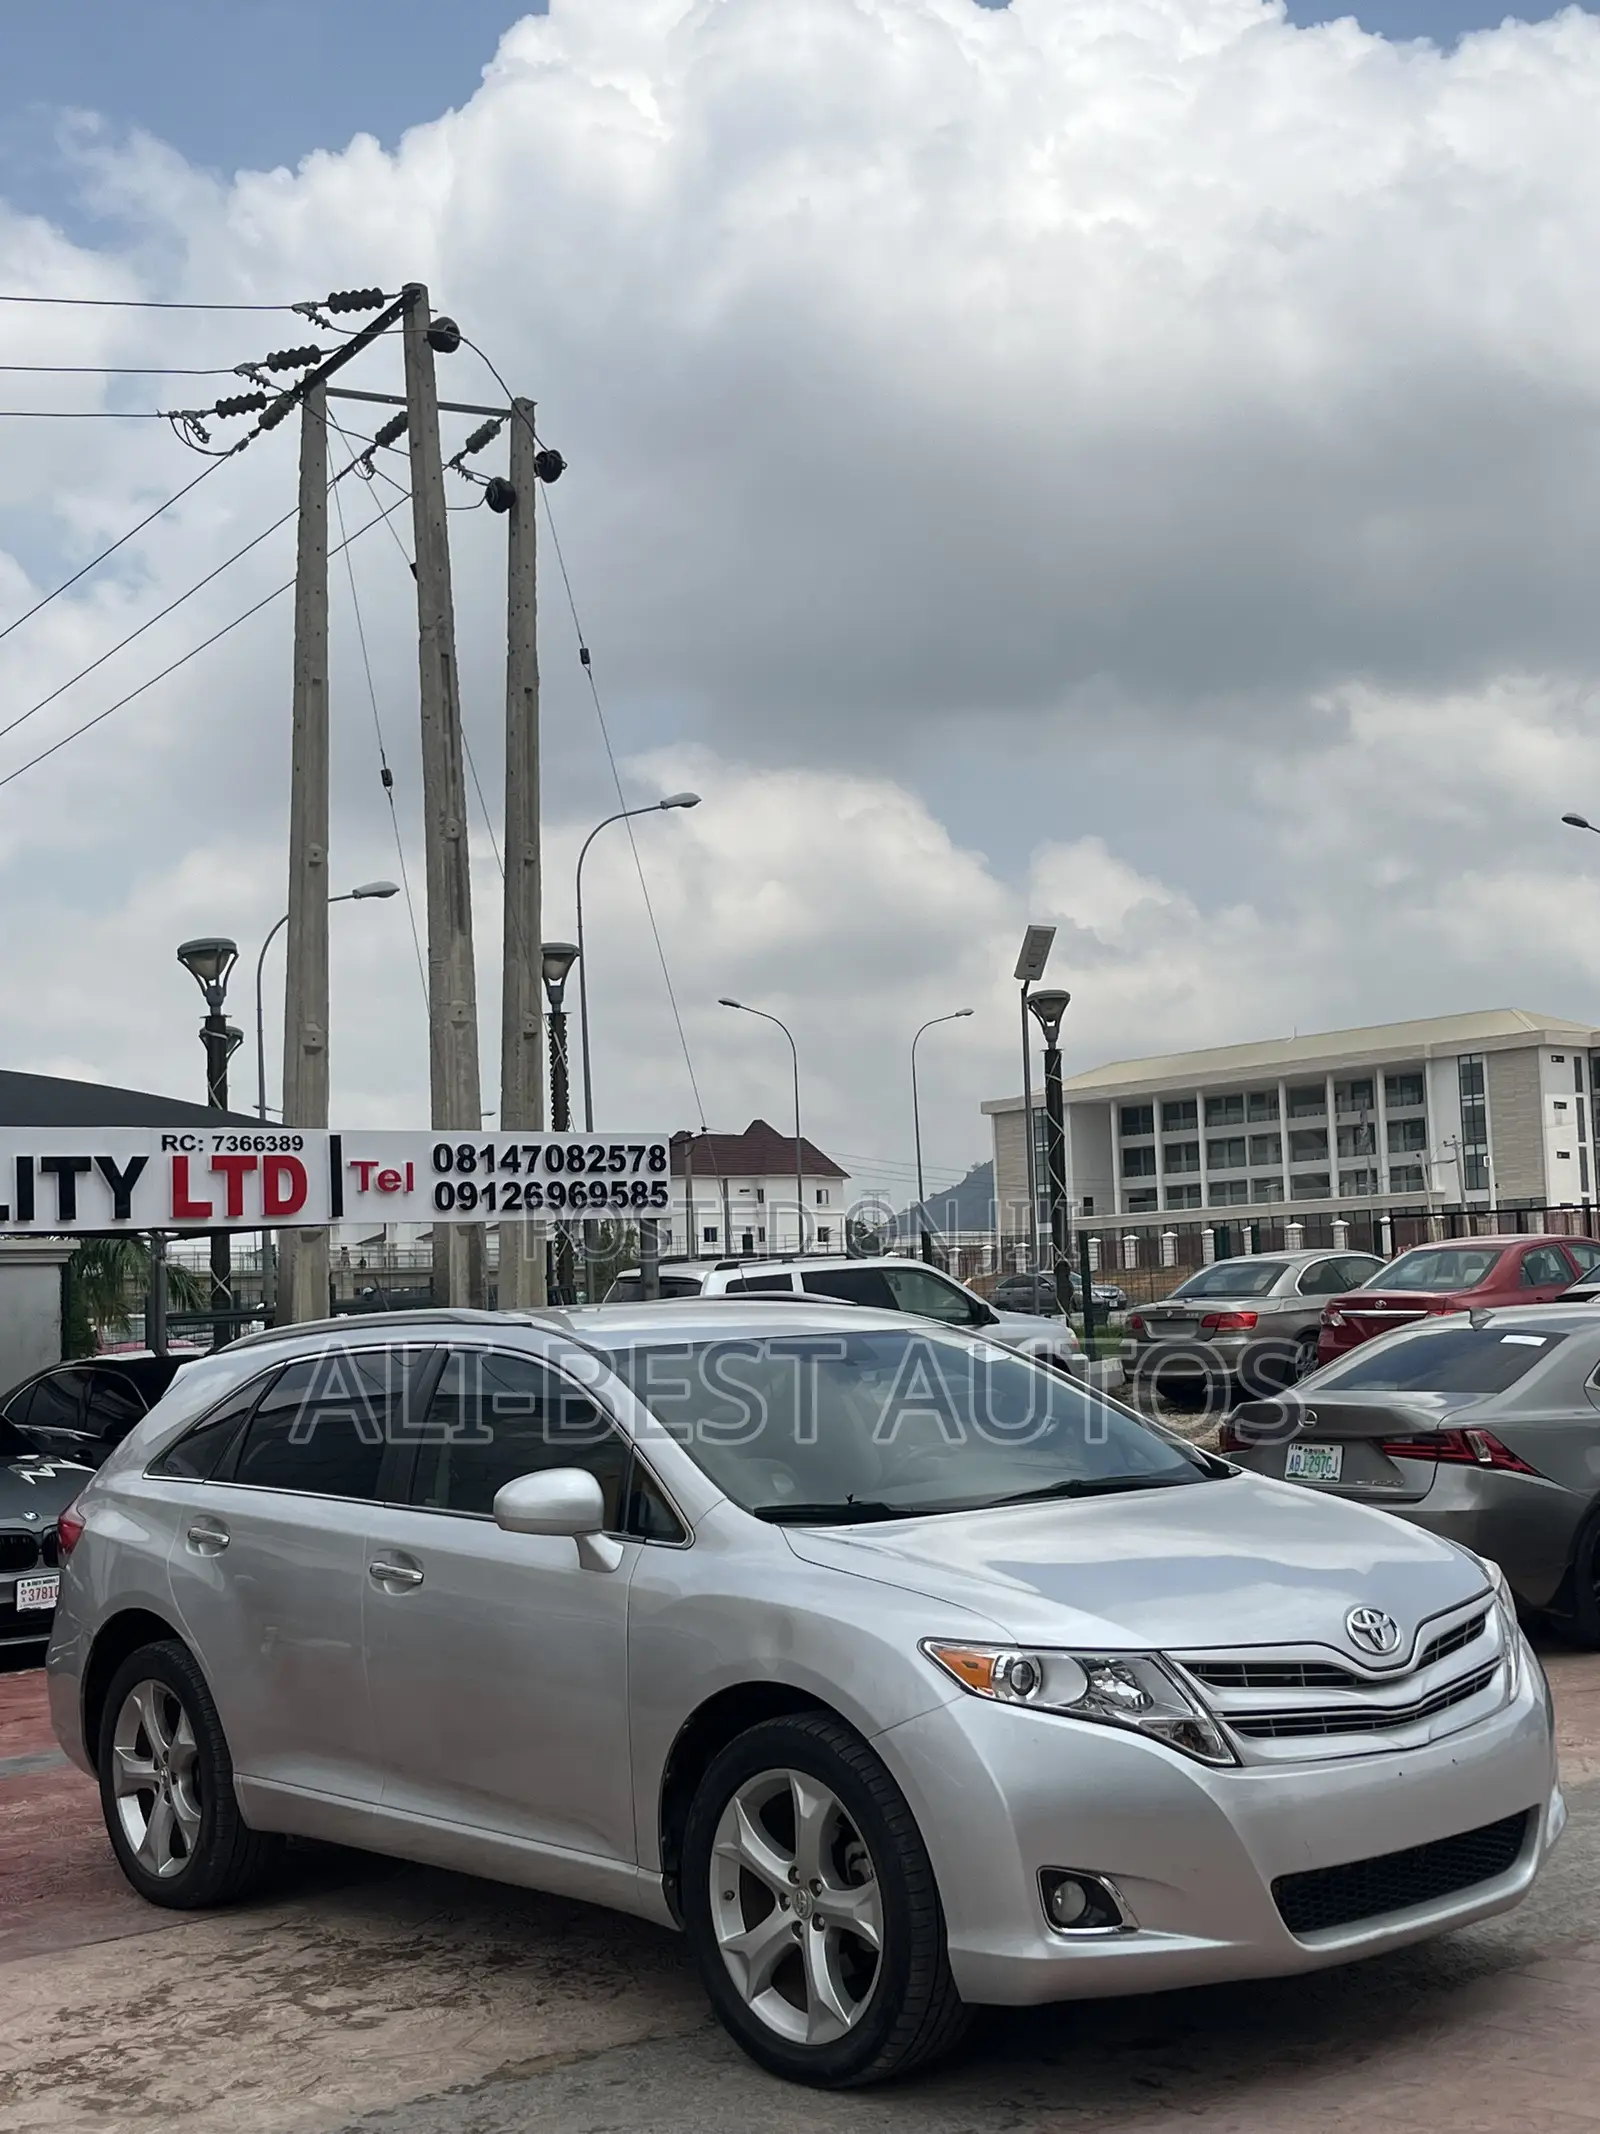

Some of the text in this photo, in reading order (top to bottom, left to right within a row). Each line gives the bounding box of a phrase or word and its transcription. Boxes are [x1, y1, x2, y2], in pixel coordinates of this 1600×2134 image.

[161, 1134, 304, 1151] RC: 7366389
[432, 1143, 667, 1174] 08147082578
[0, 1155, 308, 1220] ITY LTD
[349, 1160, 414, 1192] Tel
[434, 1180, 669, 1211] 09126969585
